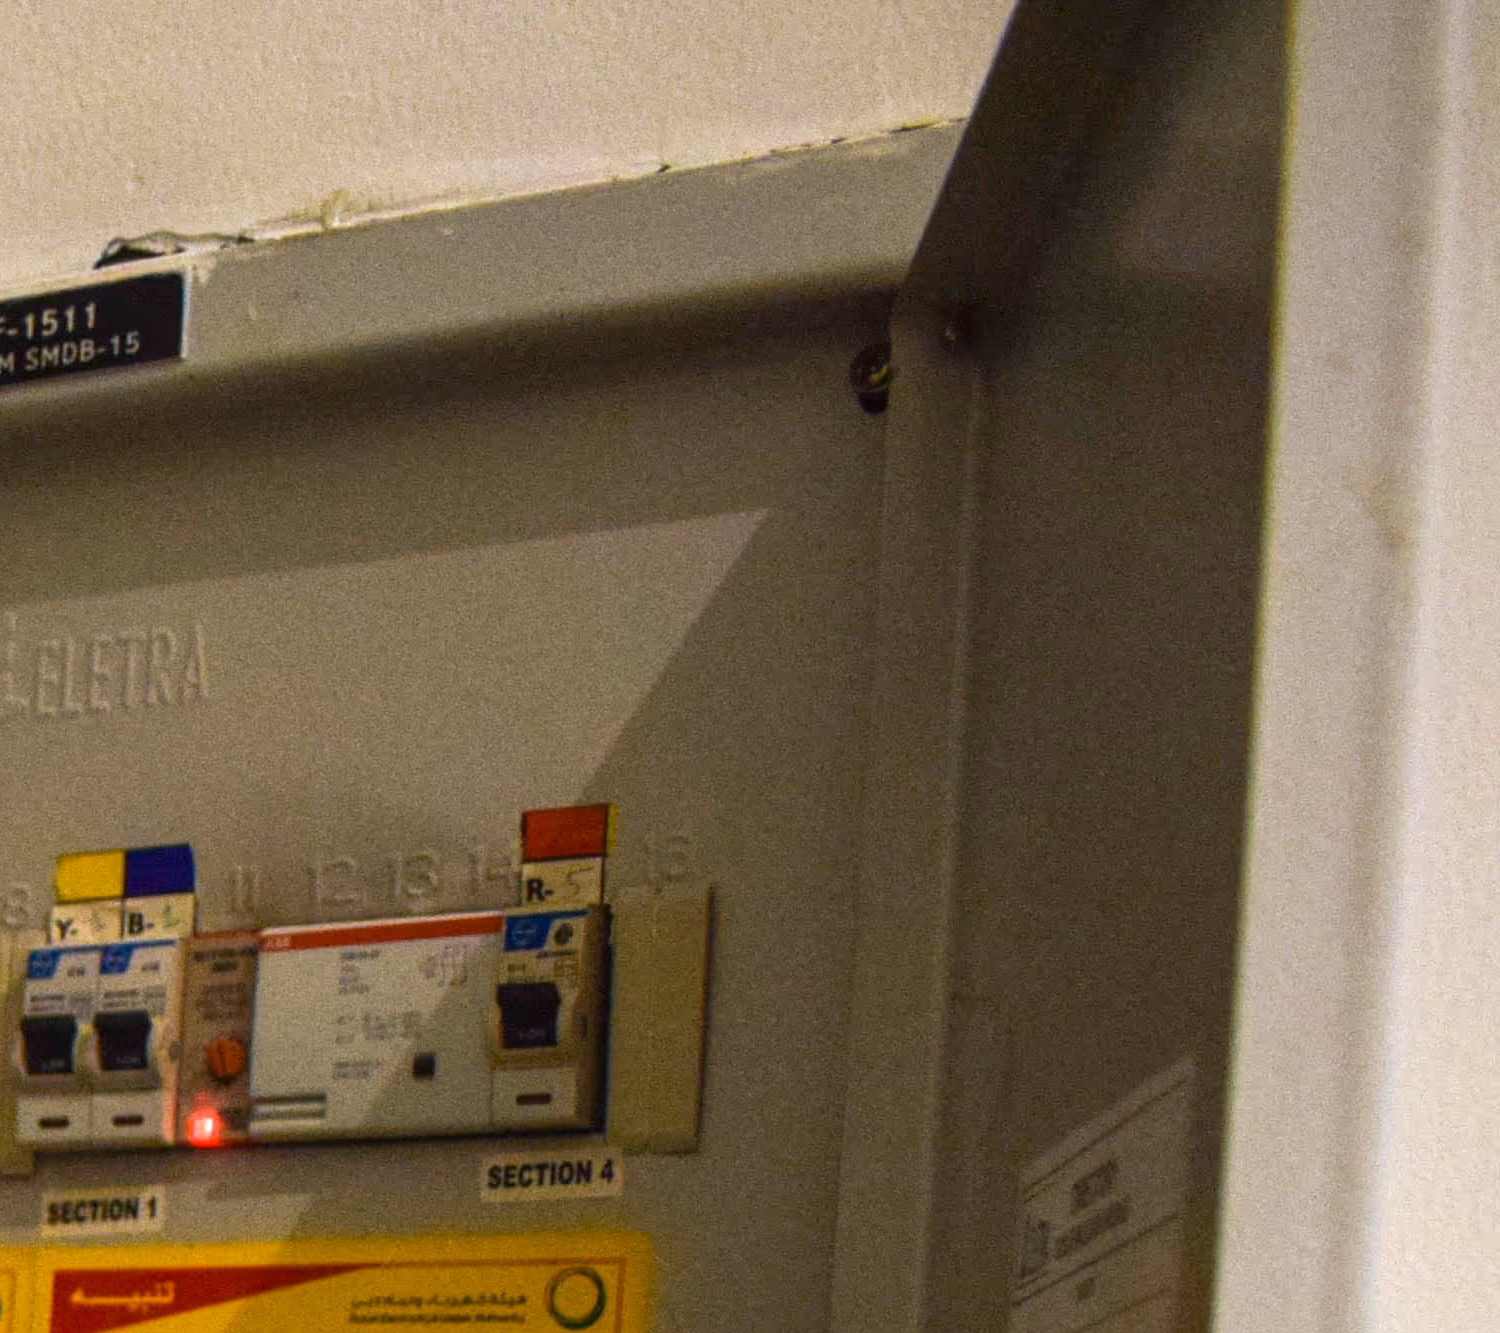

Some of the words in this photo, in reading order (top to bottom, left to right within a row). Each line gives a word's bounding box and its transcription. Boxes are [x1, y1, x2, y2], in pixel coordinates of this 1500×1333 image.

[24, 331, 141, 372] SMDB-15
[487, 1160, 593, 1190] SECTION
[599, 1158, 616, 1183] 4
[46, 1196, 140, 1225] SECTION
[146, 1196, 157, 1219] 1
